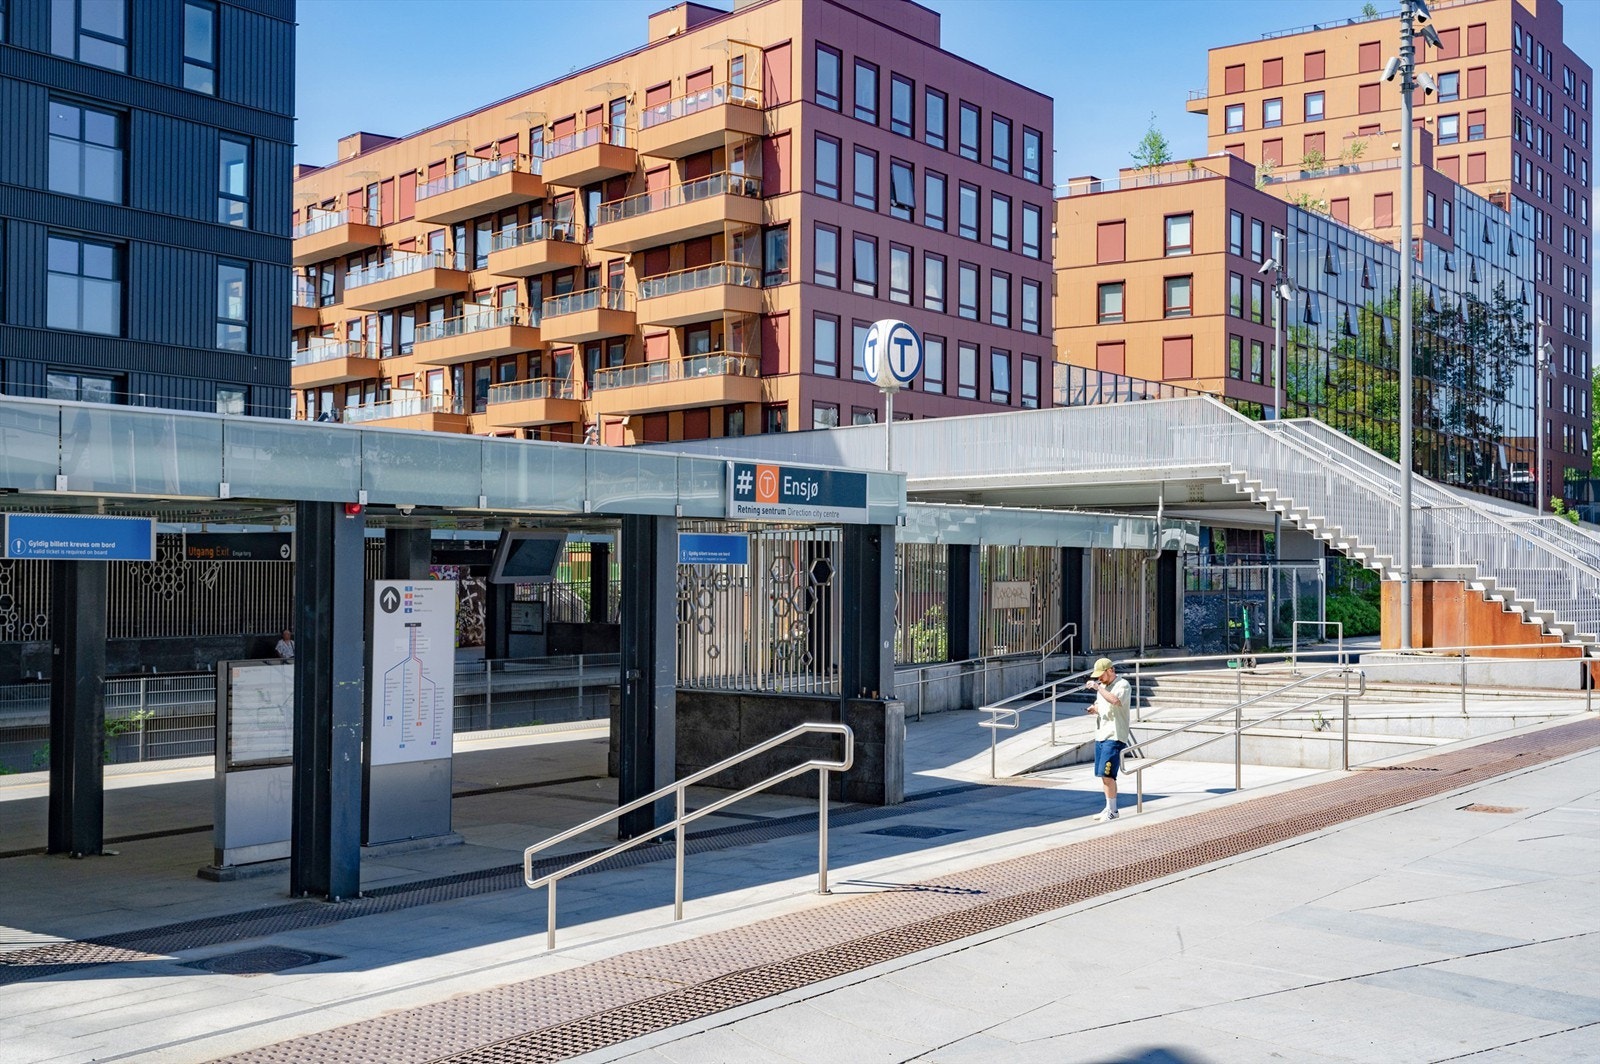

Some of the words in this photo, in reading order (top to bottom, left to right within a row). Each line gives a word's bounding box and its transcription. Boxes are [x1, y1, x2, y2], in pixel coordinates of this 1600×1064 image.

[868, 338, 877, 373] T
[894, 337, 913, 372] T
[784, 475, 819, 501] Ensjø
[737, 505, 760, 516] Retning
[761, 507, 787, 516] sentrum
[787, 508, 811, 517] Direction
[812, 509, 823, 519] city
[823, 510, 840, 518] centre
[28, 540, 49, 548] Gyldig
[50, 540, 69, 548] billett
[188, 546, 214, 558] Utgang
[216, 546, 229, 556] Exit
